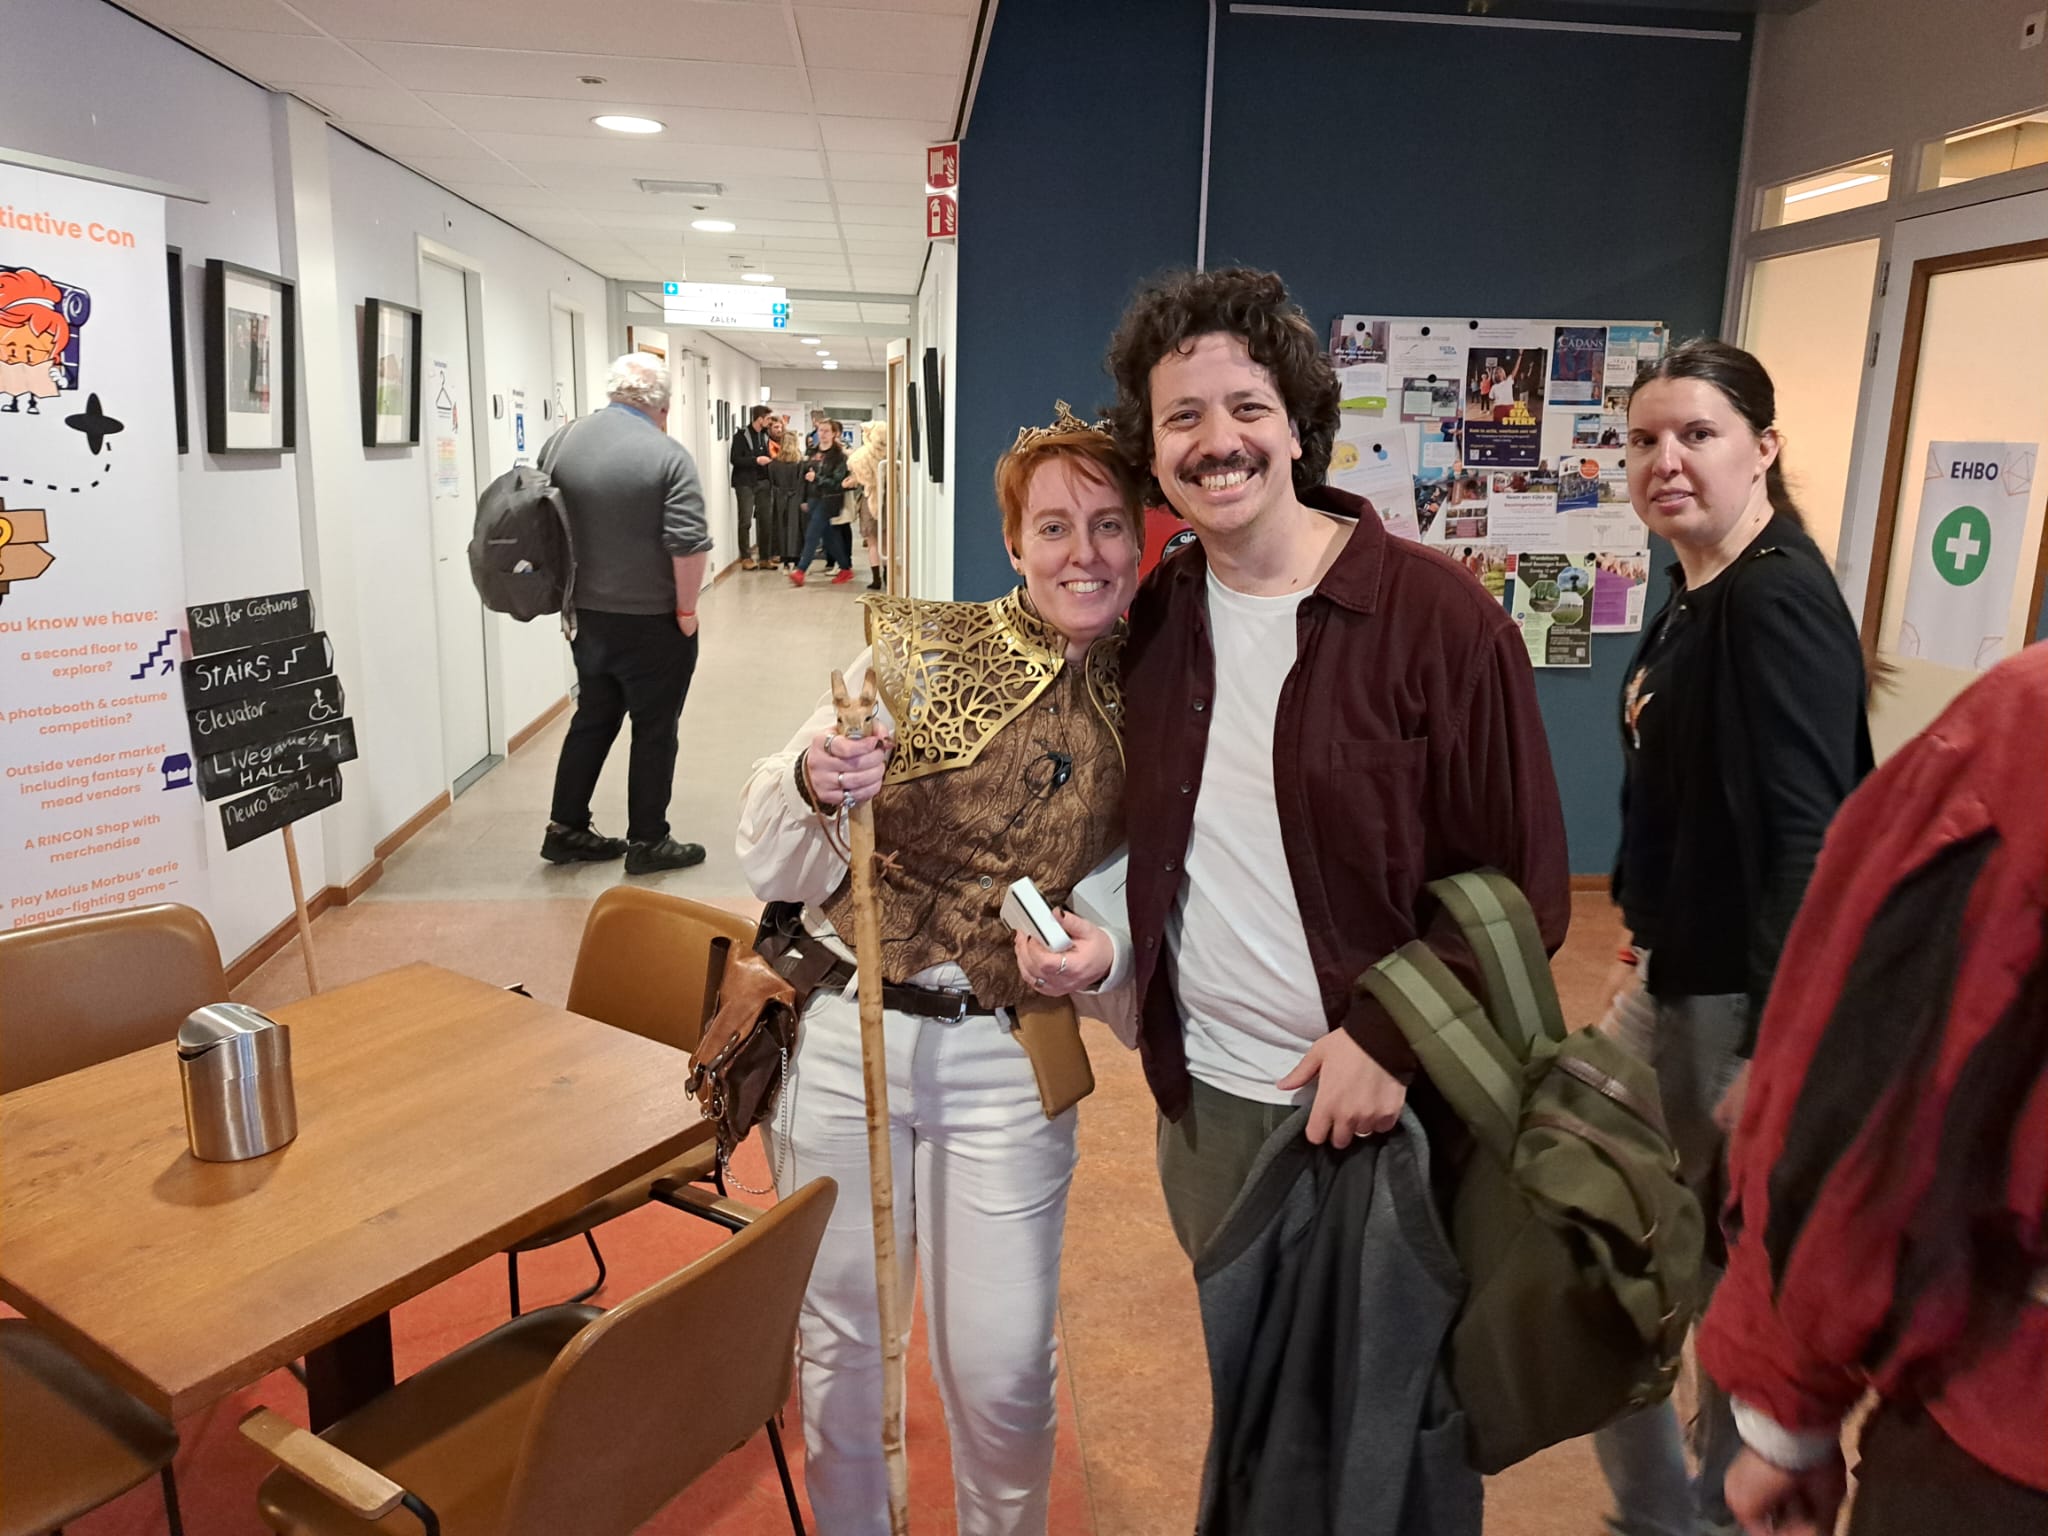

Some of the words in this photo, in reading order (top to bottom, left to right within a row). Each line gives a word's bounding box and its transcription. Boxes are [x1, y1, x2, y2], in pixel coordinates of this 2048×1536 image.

[88, 222, 135, 248] Con
[1950, 461, 1998, 481] EHBO
[27, 616, 78, 631] know
[83, 614, 107, 627] we
[112, 610, 158, 625] have:
[191, 607, 220, 628] Roll
[223, 602, 243, 627] for
[247, 597, 298, 617] Costume
[21, 651, 31, 661] a
[34, 645, 88, 660] second
[91, 642, 121, 656] floor
[124, 641, 138, 652] to
[52, 661, 113, 678] explore?
[8, 700, 95, 724] photobooth
[97, 698, 107, 709] &
[111, 691, 168, 707] costume
[195, 700, 267, 735] Elevator
[39, 712, 132, 735] competition?
[6, 760, 63, 778] Outside
[66, 752, 116, 769] vendor
[118, 743, 167, 760] market
[240, 764, 294, 787] HALL
[297, 754, 311, 771] 1
[20, 775, 89, 795] including
[92, 766, 144, 783] fantasy
[146, 762, 156, 773] &
[267, 781, 299, 804] Room
[305, 771, 316, 790] 1
[41, 793, 83, 810] mead
[86, 783, 141, 801] vendors
[25, 839, 35, 850] A
[38, 827, 93, 849] RINCON
[96, 820, 130, 836] Shop
[132, 814, 160, 828] with
[11, 894, 42, 909] Play
[45, 882, 88, 900] Malus
[147, 860, 179, 876] eerie
[127, 882, 166, 900] game
